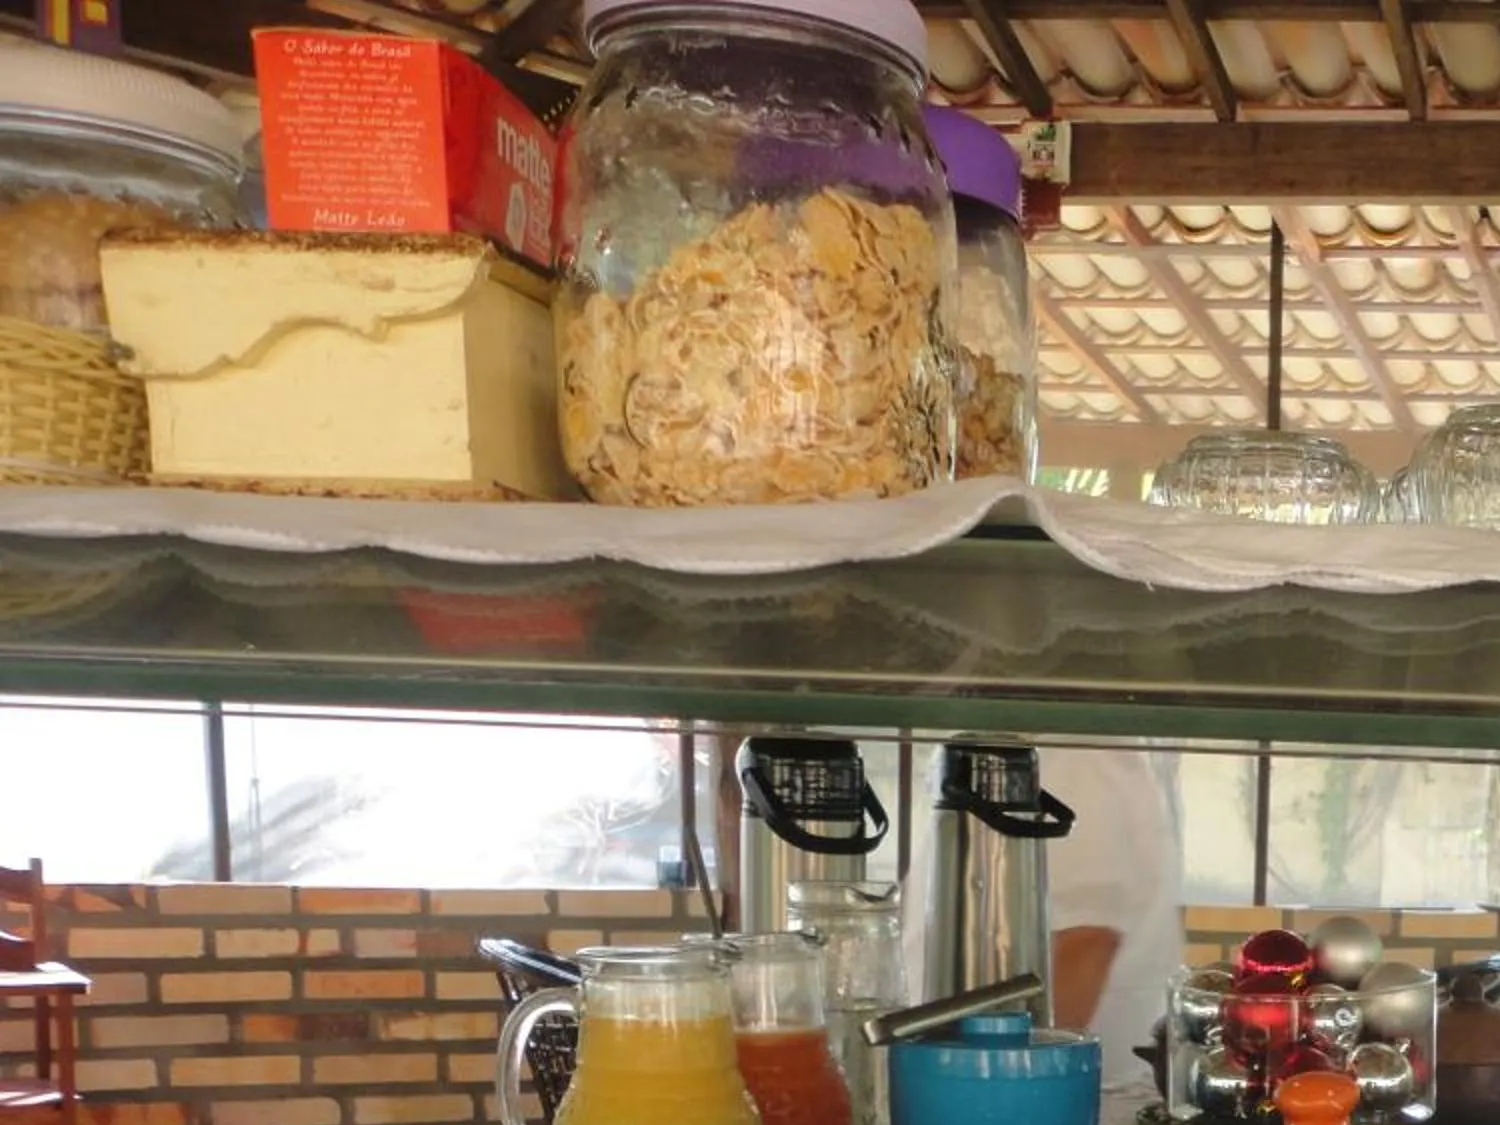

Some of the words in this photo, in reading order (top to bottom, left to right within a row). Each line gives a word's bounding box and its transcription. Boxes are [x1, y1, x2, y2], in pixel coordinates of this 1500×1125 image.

[284, 39, 297, 53] O
[371, 41, 412, 58] Brasil
[497, 116, 550, 195] matte
[313, 207, 359, 226] Matte
